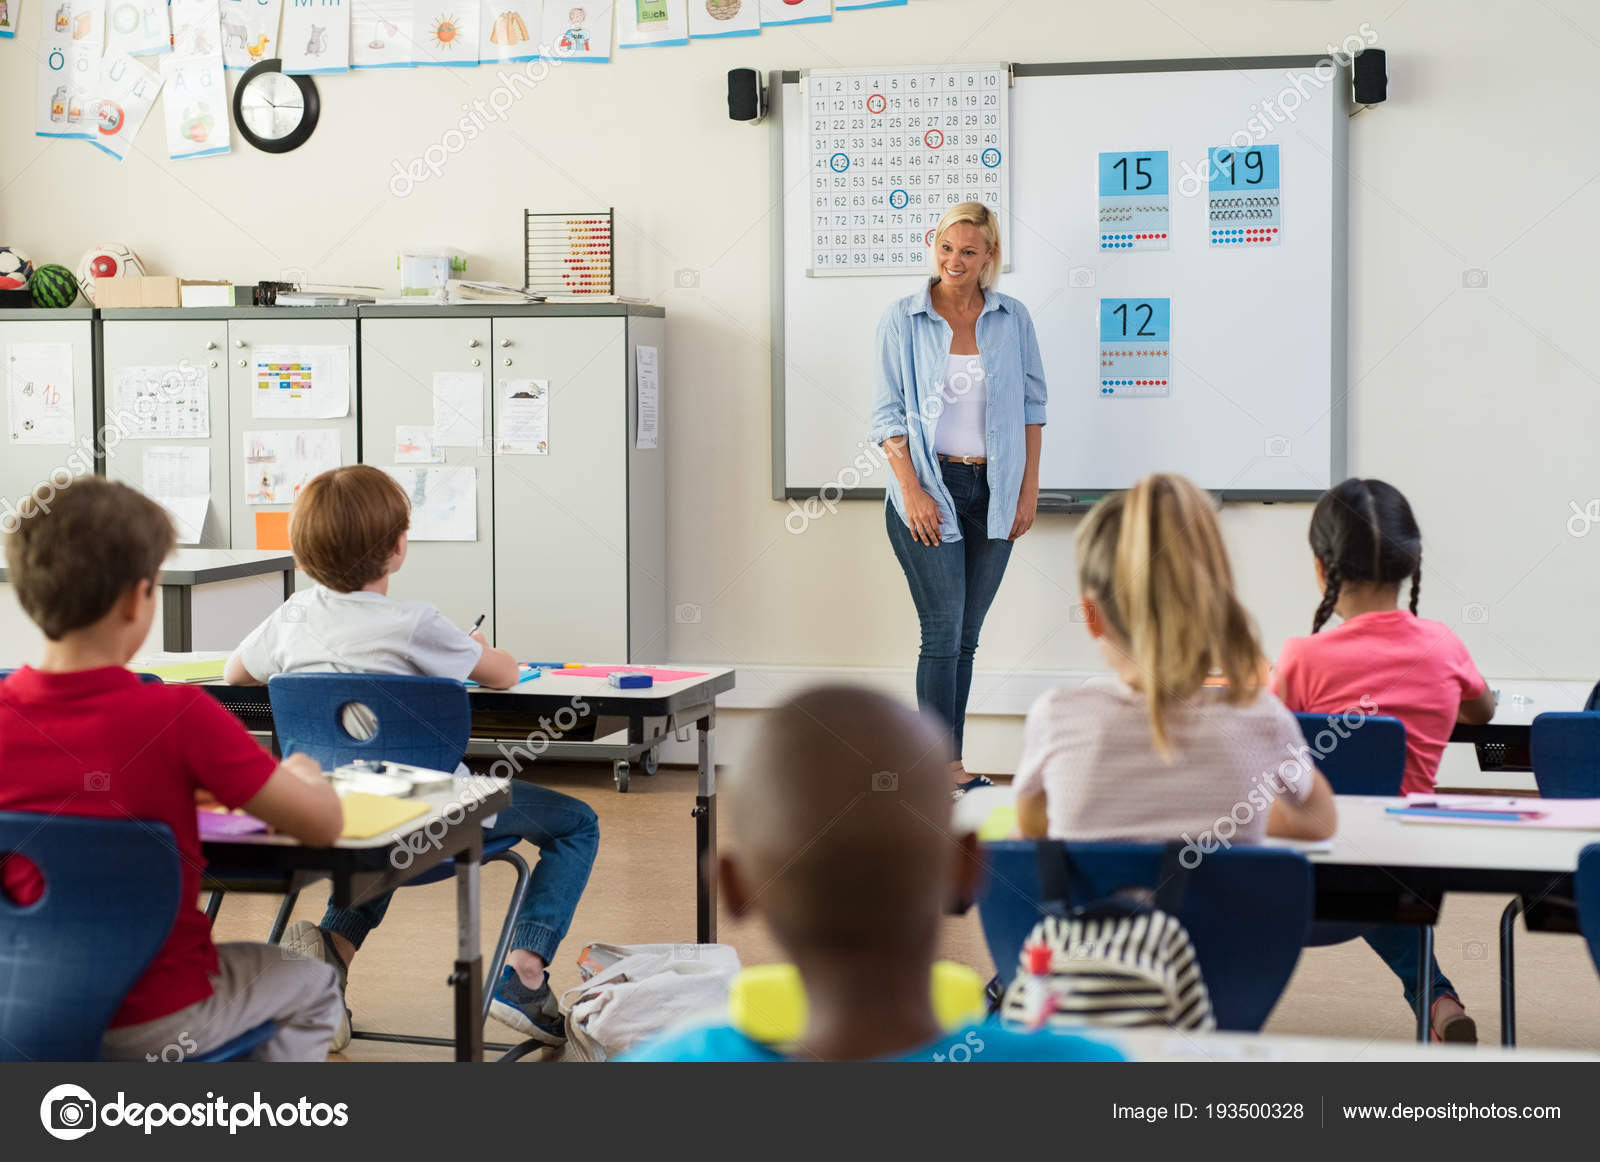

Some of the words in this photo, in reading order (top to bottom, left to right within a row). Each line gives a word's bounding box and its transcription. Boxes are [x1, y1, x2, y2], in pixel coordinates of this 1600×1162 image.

[642, 10, 666, 19] Buch
[48, 48, 64, 70] Ö
[110, 58, 126, 82] Ü
[818, 82, 822, 91] 1
[836, 81, 841, 91] 2
[854, 81, 860, 91] 3
[873, 80, 879, 88] 4
[892, 79, 898, 89] 5
[910, 78, 917, 88] 6
[930, 77, 935, 87] 7
[949, 77, 955, 87] 8
[968, 76, 974, 86] 9
[984, 75, 996, 86] 10
[816, 101, 825, 111] 11
[834, 100, 844, 110] 12
[852, 100, 863, 110] 13
[871, 100, 882, 109] 14
[891, 98, 901, 108] 15
[908, 98, 920, 108] 16
[928, 97, 939, 106] 17
[946, 96, 958, 106] 18
[966, 95, 977, 106] 19
[984, 95, 996, 105] 20
[815, 121, 826, 130] 21
[833, 120, 845, 130] 22
[852, 119, 864, 129] 23
[871, 119, 882, 128] 24
[889, 118, 901, 128] 25
[908, 117, 920, 127] 26
[927, 116, 939, 127] 27
[946, 116, 958, 126] 28
[965, 115, 977, 125] 29
[984, 114, 997, 125] 30
[816, 140, 826, 150] 31
[834, 139, 845, 149] 32
[852, 138, 864, 149] 33
[871, 138, 883, 147] 34
[890, 137, 902, 147] 35
[908, 136, 921, 147] 36
[927, 136, 939, 146] 37
[946, 135, 958, 145] 38
[966, 135, 978, 145] 39
[984, 134, 997, 144] 40
[816, 159, 827, 168] 41
[834, 158, 846, 168] 42
[852, 157, 864, 167] 43
[872, 157, 883, 166] 44
[890, 156, 902, 166] 45
[909, 156, 921, 165] 46
[928, 155, 940, 164] 47
[946, 154, 959, 165] 48
[966, 154, 978, 164] 49
[985, 152, 997, 163] 50
[1113, 157, 1152, 191] 15
[1220, 151, 1264, 186] 19
[817, 178, 827, 188] 51
[834, 177, 846, 187] 52
[853, 176, 865, 187] 53
[872, 176, 883, 186] 54
[890, 175, 902, 186] 55
[909, 175, 921, 185] 56
[928, 174, 940, 184] 57
[947, 174, 959, 184] 58
[966, 173, 978, 183] 59
[985, 173, 997, 183] 60
[816, 197, 827, 207] 61
[834, 196, 846, 207] 62
[853, 196, 865, 206] 63
[872, 196, 883, 205] 64
[910, 194, 922, 204] 66
[928, 194, 940, 204] 67
[947, 193, 959, 203] 68
[966, 193, 978, 201] 69
[985, 192, 998, 202] 70
[817, 216, 828, 225] 71
[835, 216, 847, 225] 72
[853, 215, 865, 225] 73
[872, 215, 884, 224] 74
[891, 214, 903, 224] 75
[910, 213, 922, 223] 76
[929, 214, 940, 223] 77
[817, 235, 828, 245] 81
[835, 235, 847, 245] 82
[854, 234, 866, 244] 83
[872, 234, 884, 244] 84
[891, 233, 903, 243] 85
[910, 233, 922, 243] 86
[817, 254, 828, 264] 91
[835, 254, 847, 264] 92
[854, 253, 866, 263] 93
[873, 253, 884, 263] 94
[891, 252, 904, 262] 95
[910, 252, 922, 262] 96
[1113, 303, 1156, 336] 12
